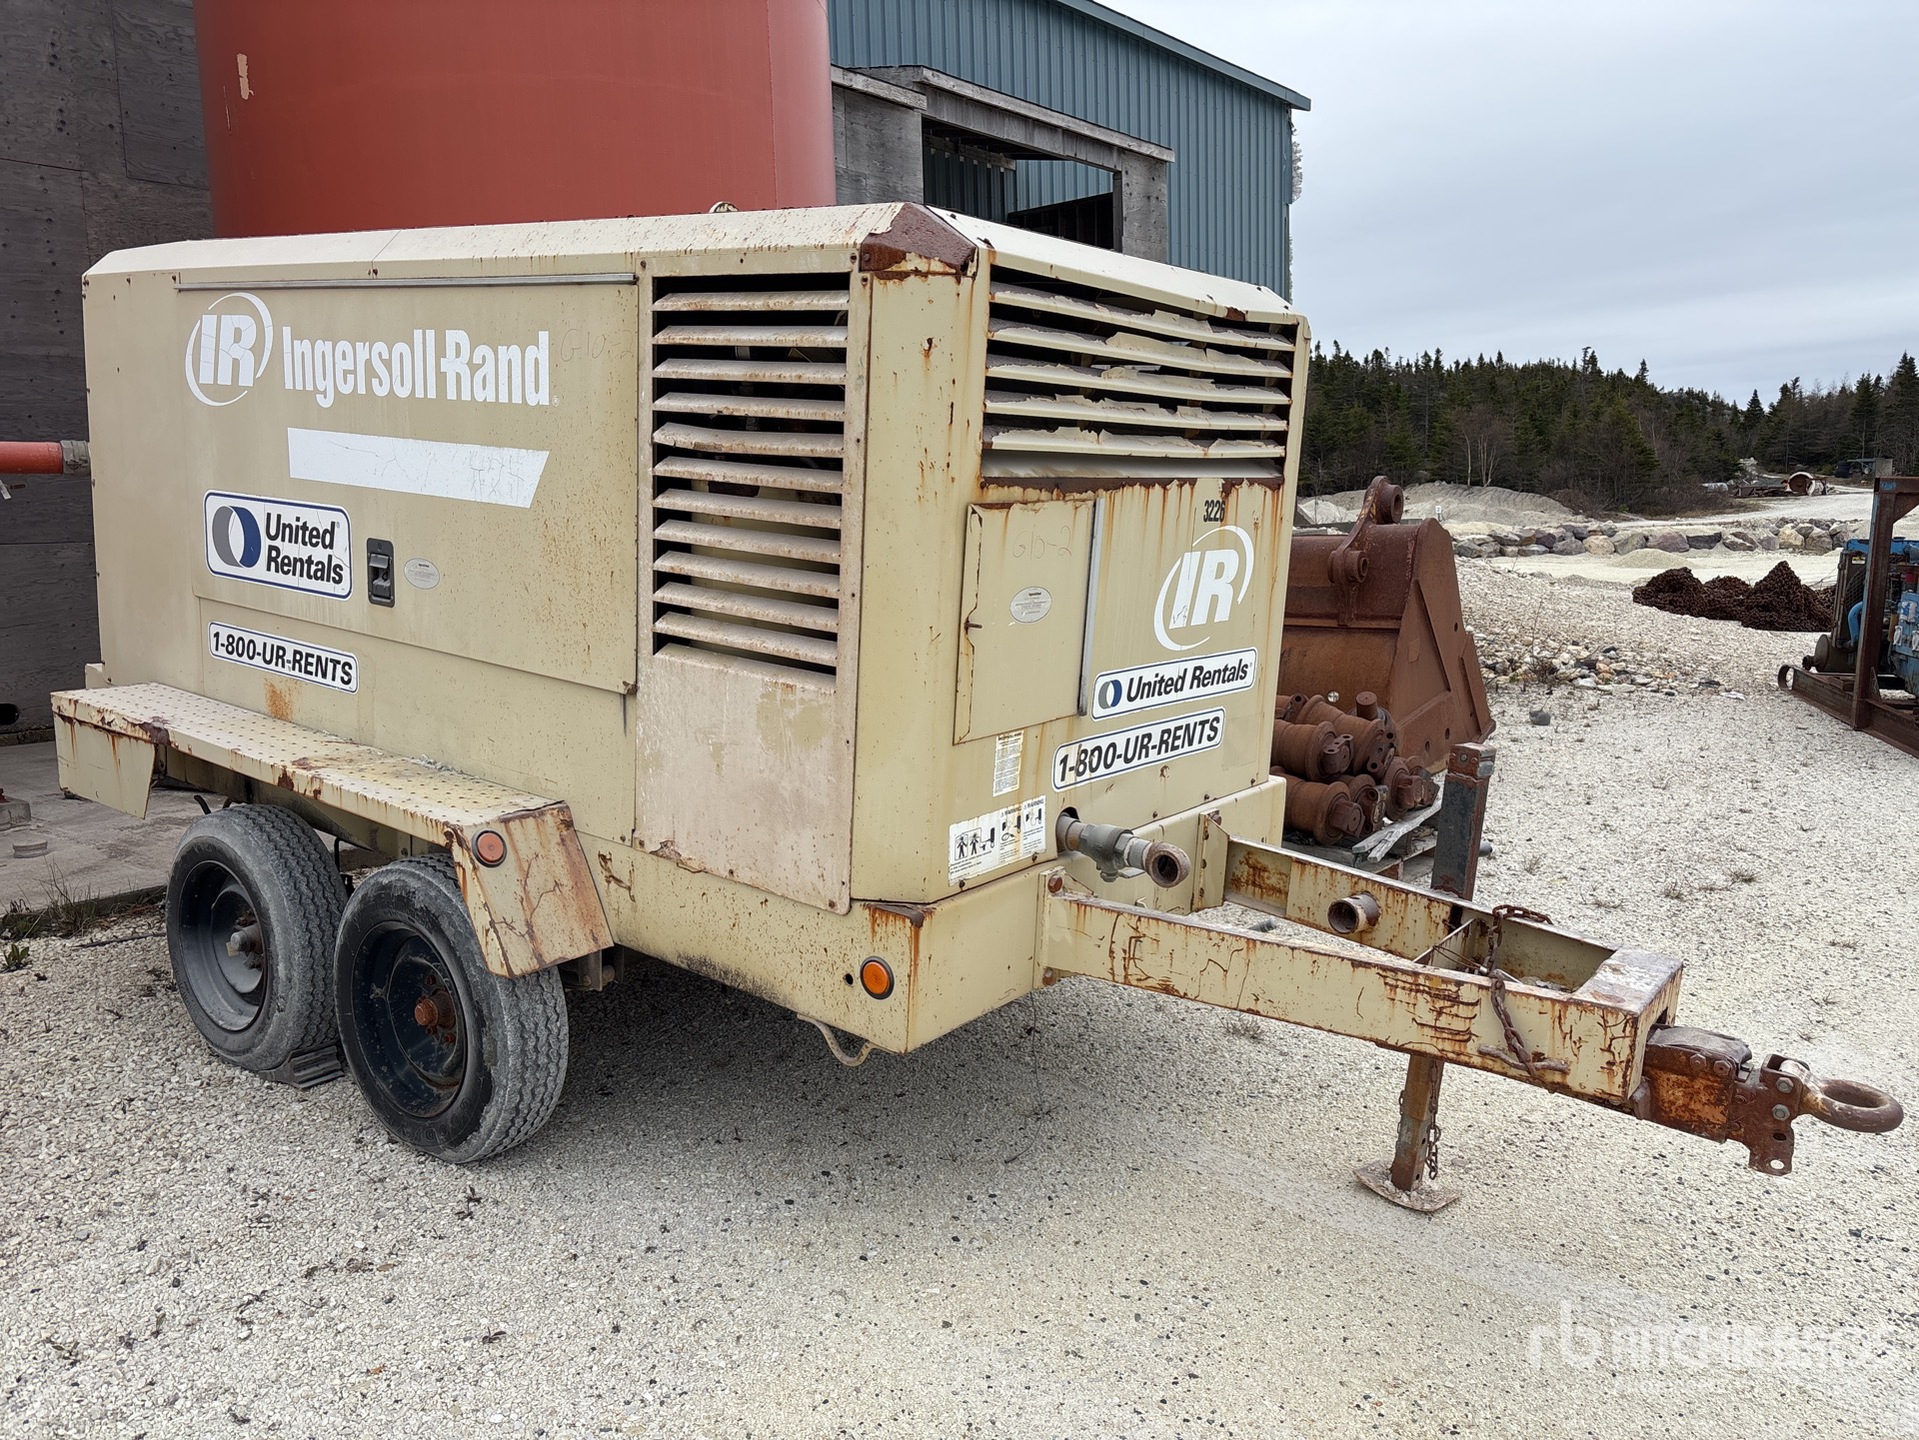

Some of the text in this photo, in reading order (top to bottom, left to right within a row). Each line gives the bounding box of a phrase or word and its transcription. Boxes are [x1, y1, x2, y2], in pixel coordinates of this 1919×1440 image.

[199, 314, 257, 387] IR
[265, 512, 336, 551] United
[1203, 499, 1226, 523] 3226
[266, 544, 344, 585] Rentals
[1168, 548, 1240, 630] IR
[213, 631, 353, 686] 1-800-UR-RENTS
[1126, 658, 1249, 703] United Rentals
[1059, 716, 1221, 782] 1-800-UR-RENTS
